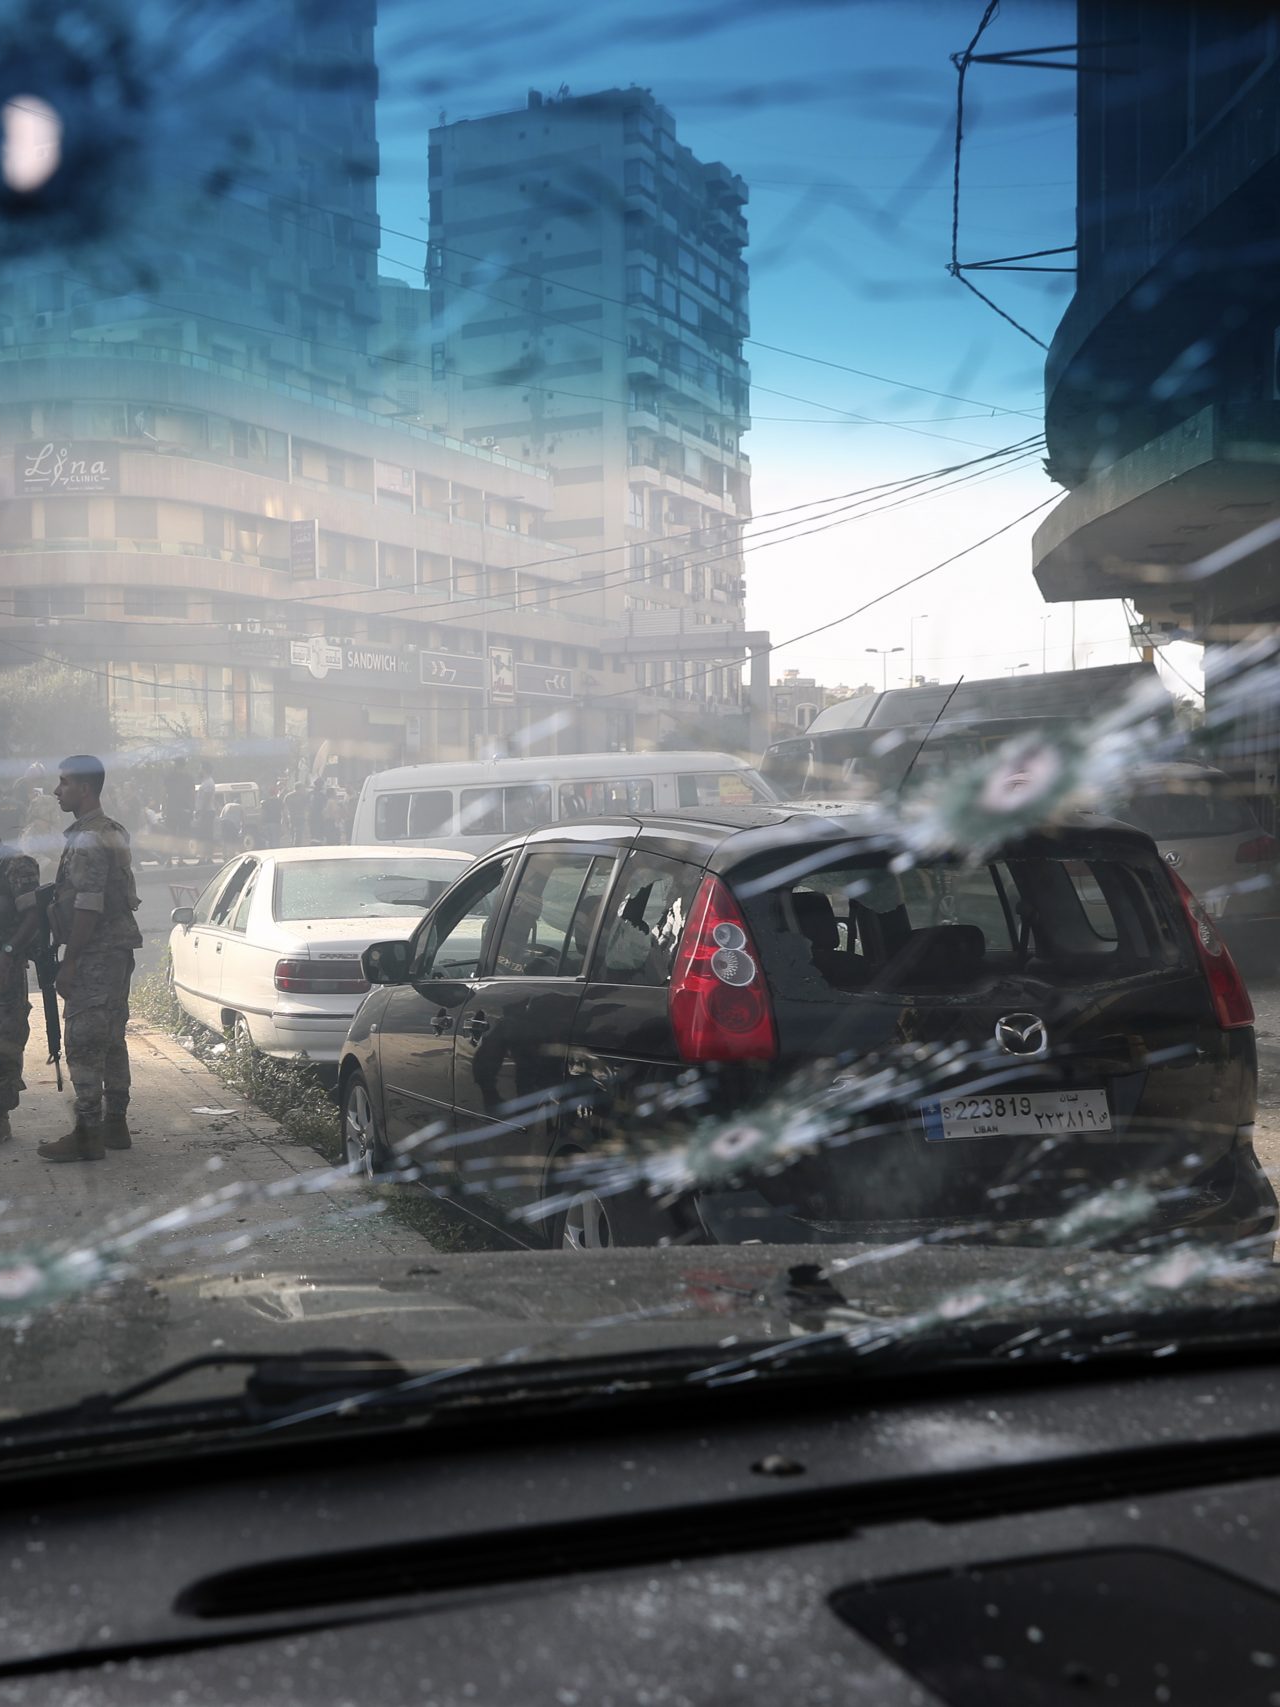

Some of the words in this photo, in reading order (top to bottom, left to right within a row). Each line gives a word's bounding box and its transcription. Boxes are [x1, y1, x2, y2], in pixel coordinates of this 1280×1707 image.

[70, 474, 99, 483] CLINIC
[347, 650, 397, 673] SANDWICH
[1059, 1093, 1079, 1103] لبنان
[942, 1107, 951, 1119] S
[954, 1097, 1032, 1121] 223819
[1034, 1109, 1097, 1129] ٢٢٣٨١٩
[973, 1125, 999, 1134] LIBAN
